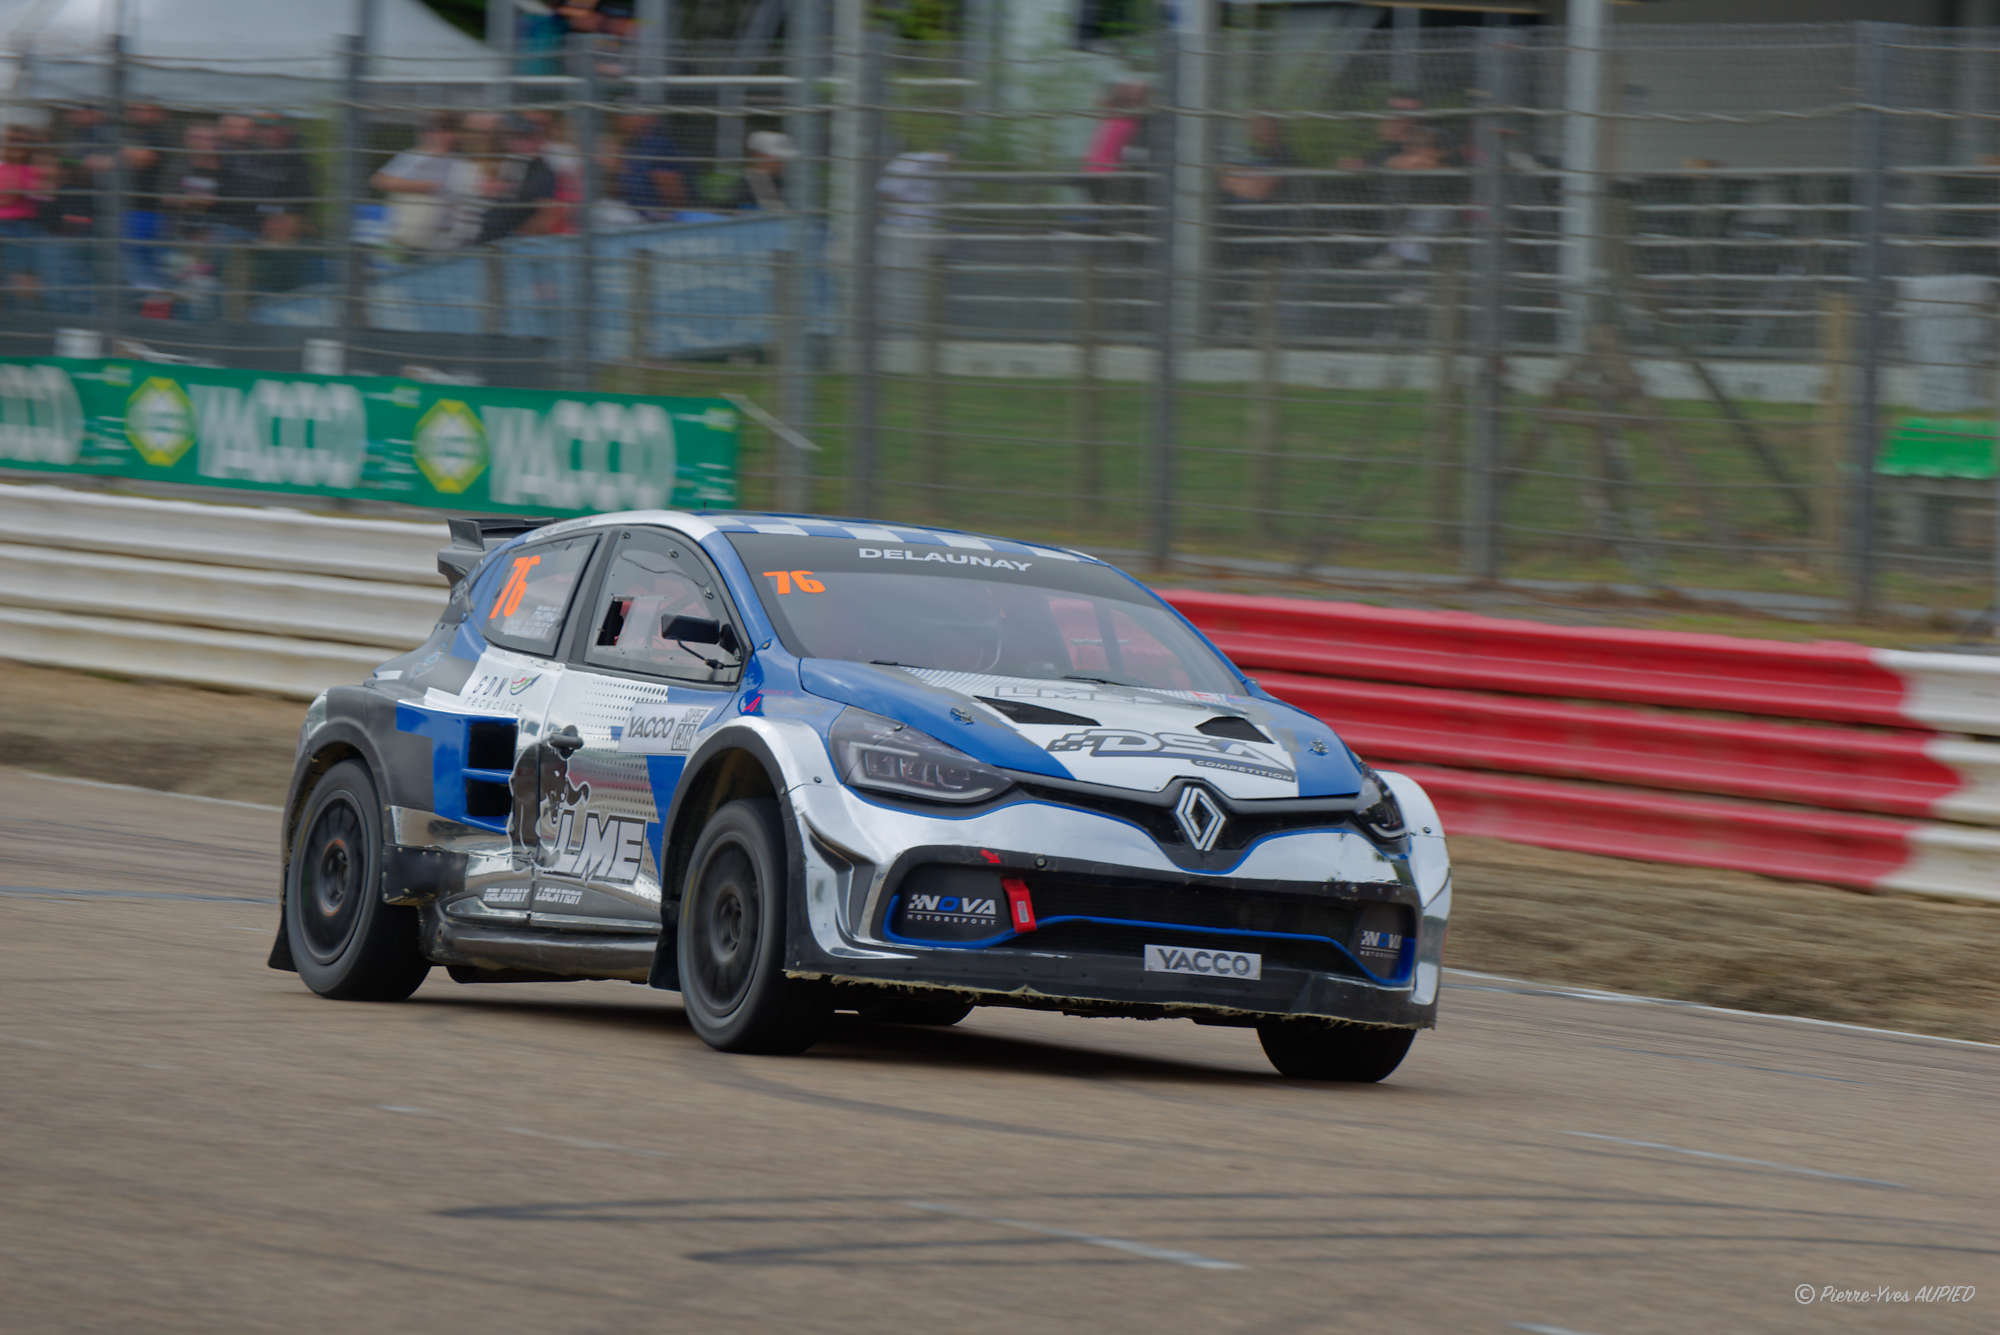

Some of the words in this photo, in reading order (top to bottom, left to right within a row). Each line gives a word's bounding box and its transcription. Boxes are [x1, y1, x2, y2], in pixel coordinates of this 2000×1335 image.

[187, 378, 367, 490] YACCO
[481, 399, 677, 511] YACCO
[858, 547, 1032, 573] DELAUNAY
[489, 555, 541, 619] 76
[763, 570, 826, 595] 76
[627, 715, 675, 739] YACCO
[1195, 759, 1294, 781] COMPETITION
[547, 809, 648, 887] LME
[908, 894, 997, 915] NOVA
[906, 914, 996, 926] MOTORSPORT
[1158, 948, 1250, 976] YACCO
